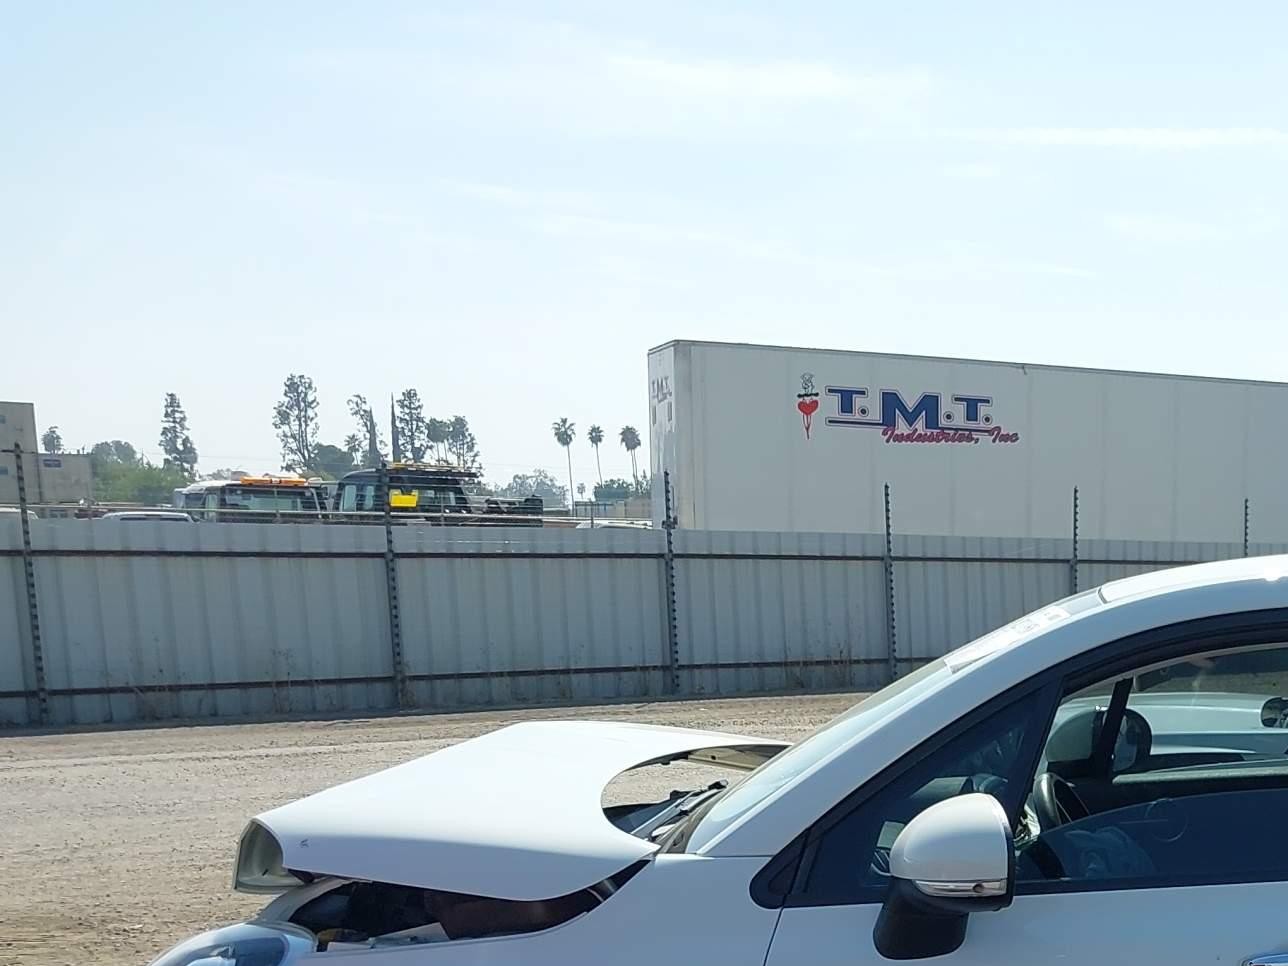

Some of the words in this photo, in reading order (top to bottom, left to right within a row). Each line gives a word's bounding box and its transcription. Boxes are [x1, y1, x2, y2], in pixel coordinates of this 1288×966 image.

[825, 386, 993, 431] T.M.T.
[881, 426, 980, 444] Industries,
[988, 426, 1020, 444] Inc
